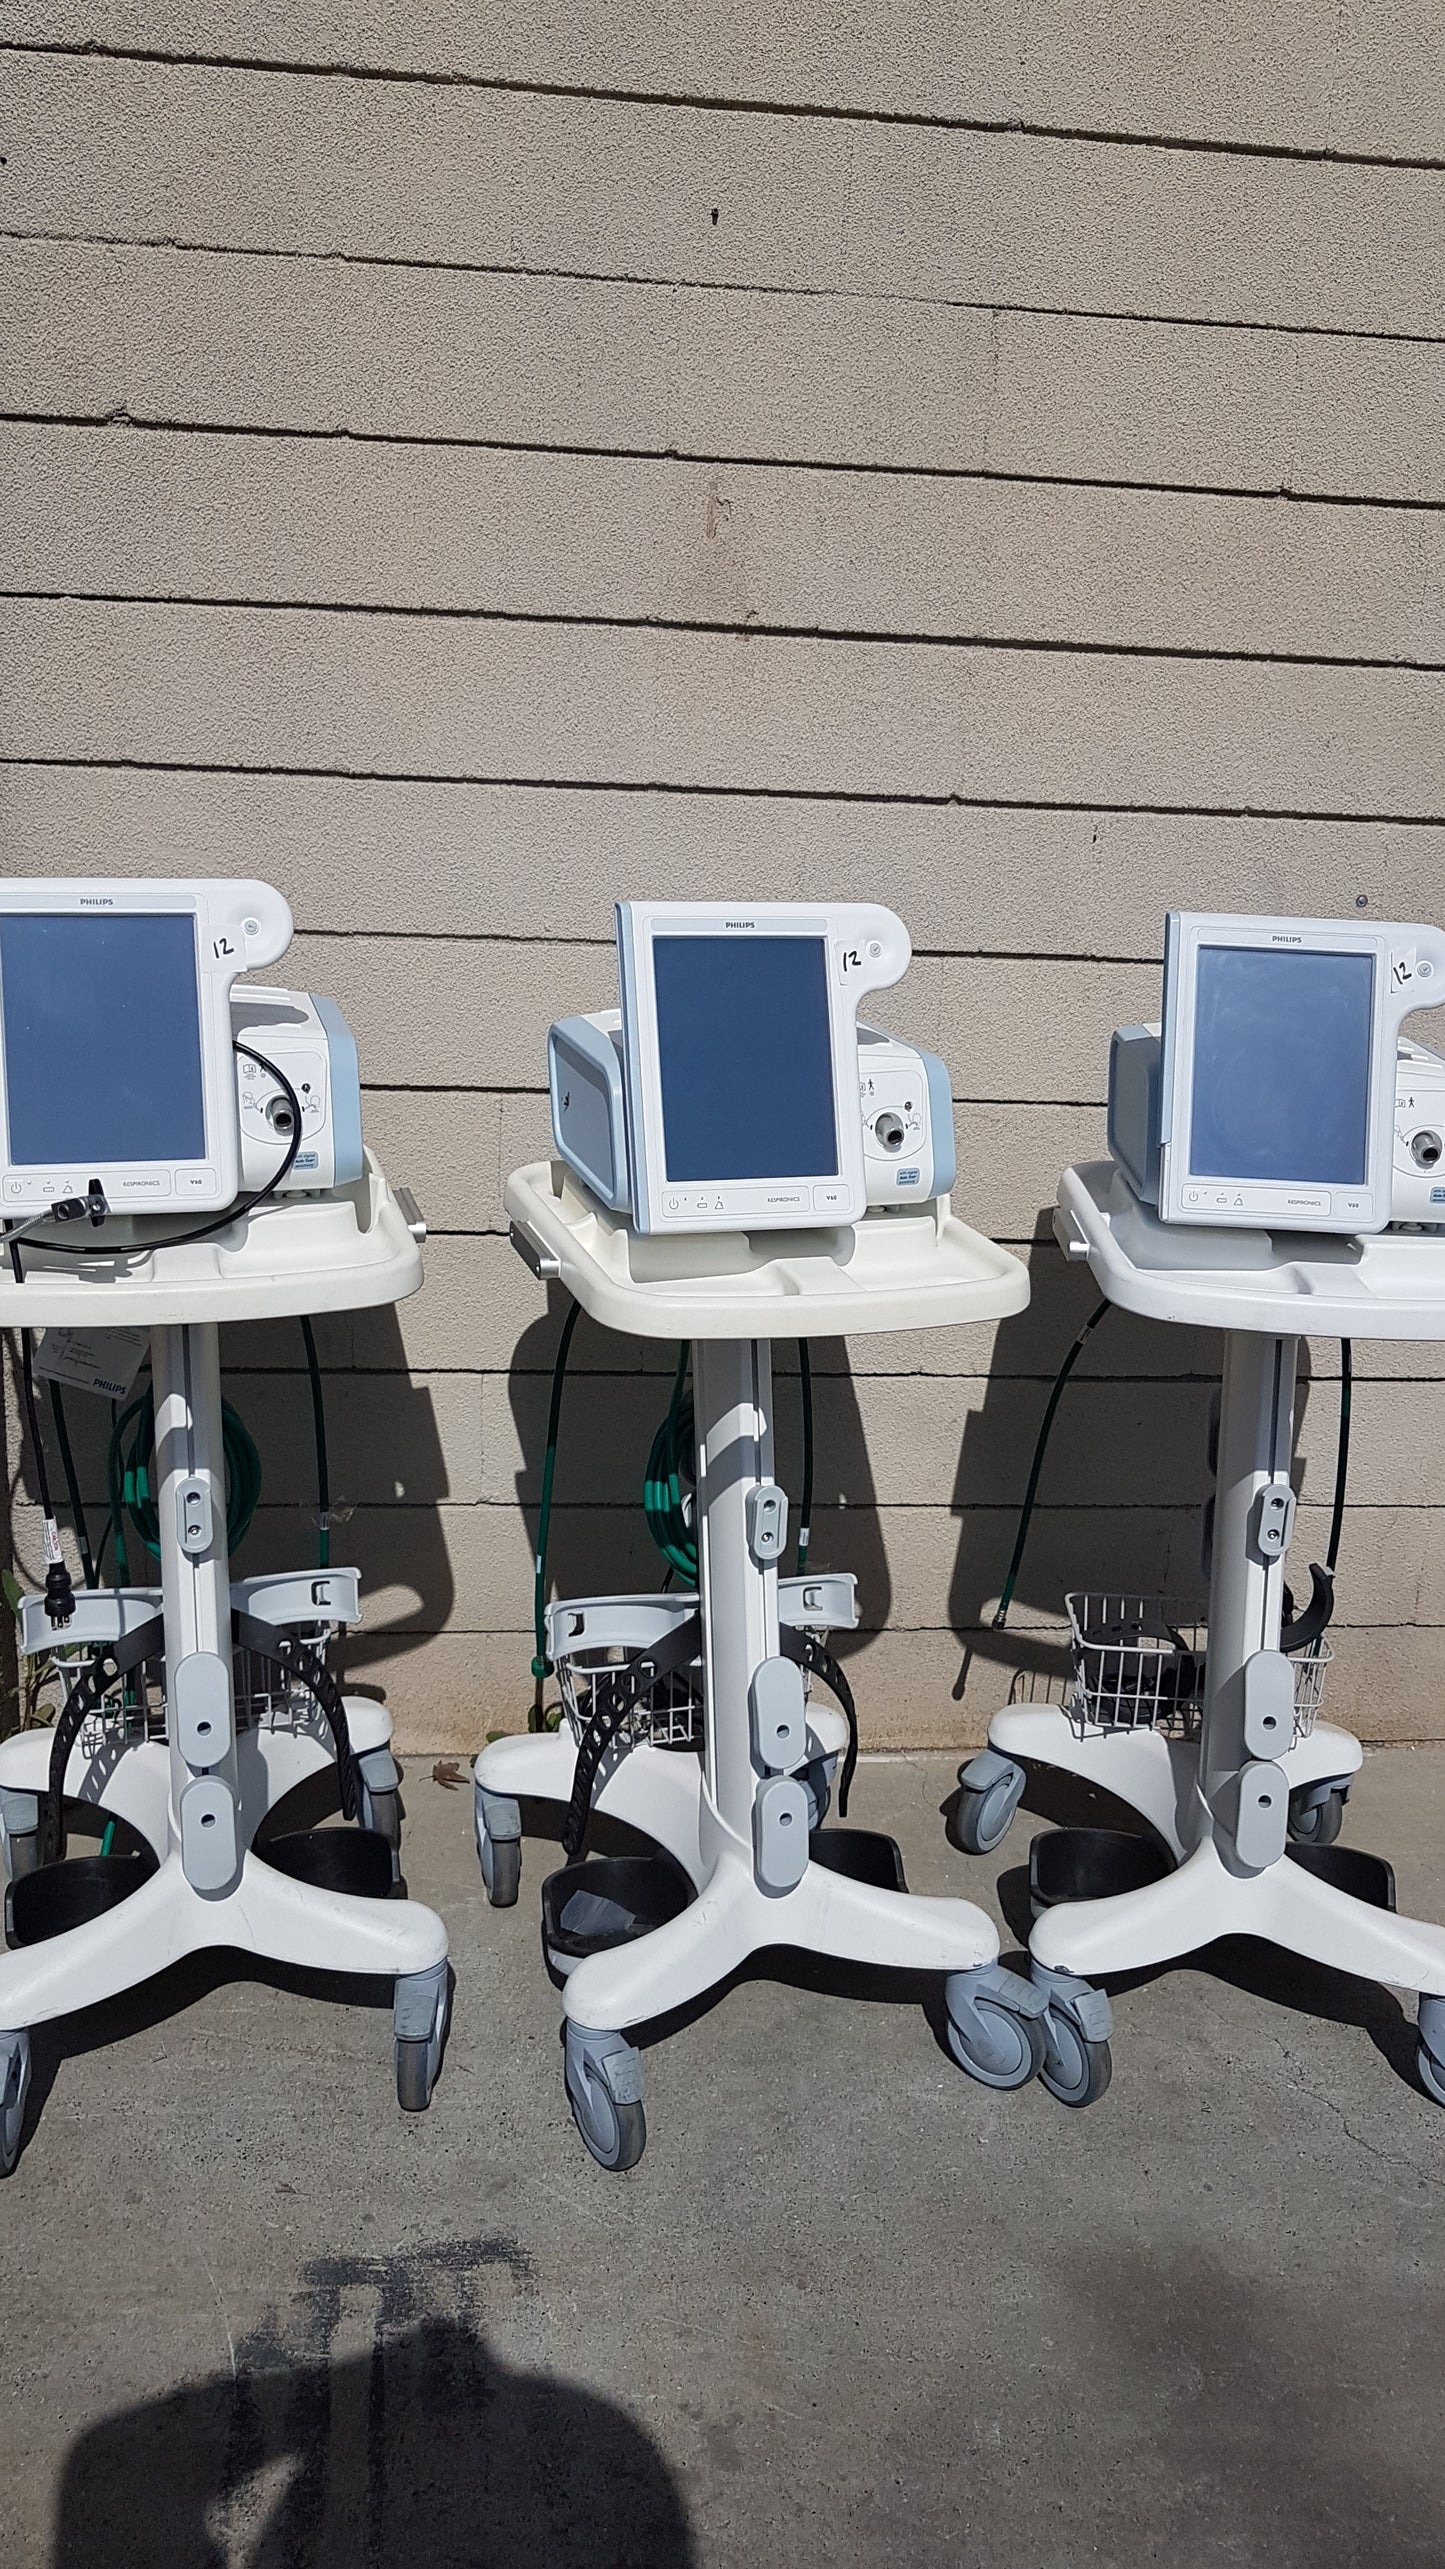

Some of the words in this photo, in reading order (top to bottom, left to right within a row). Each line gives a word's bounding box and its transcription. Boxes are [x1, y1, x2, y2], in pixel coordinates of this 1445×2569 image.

[80, 898, 114, 906] PHILIPS
[725, 921, 756, 929] PHILIPS
[213, 937, 235, 959] 12
[1272, 935, 1302, 944] PHILIPS
[843, 950, 862, 972] 12
[1393, 961, 1413, 985] 12
[93, 1378, 127, 1395] PHILIPS
